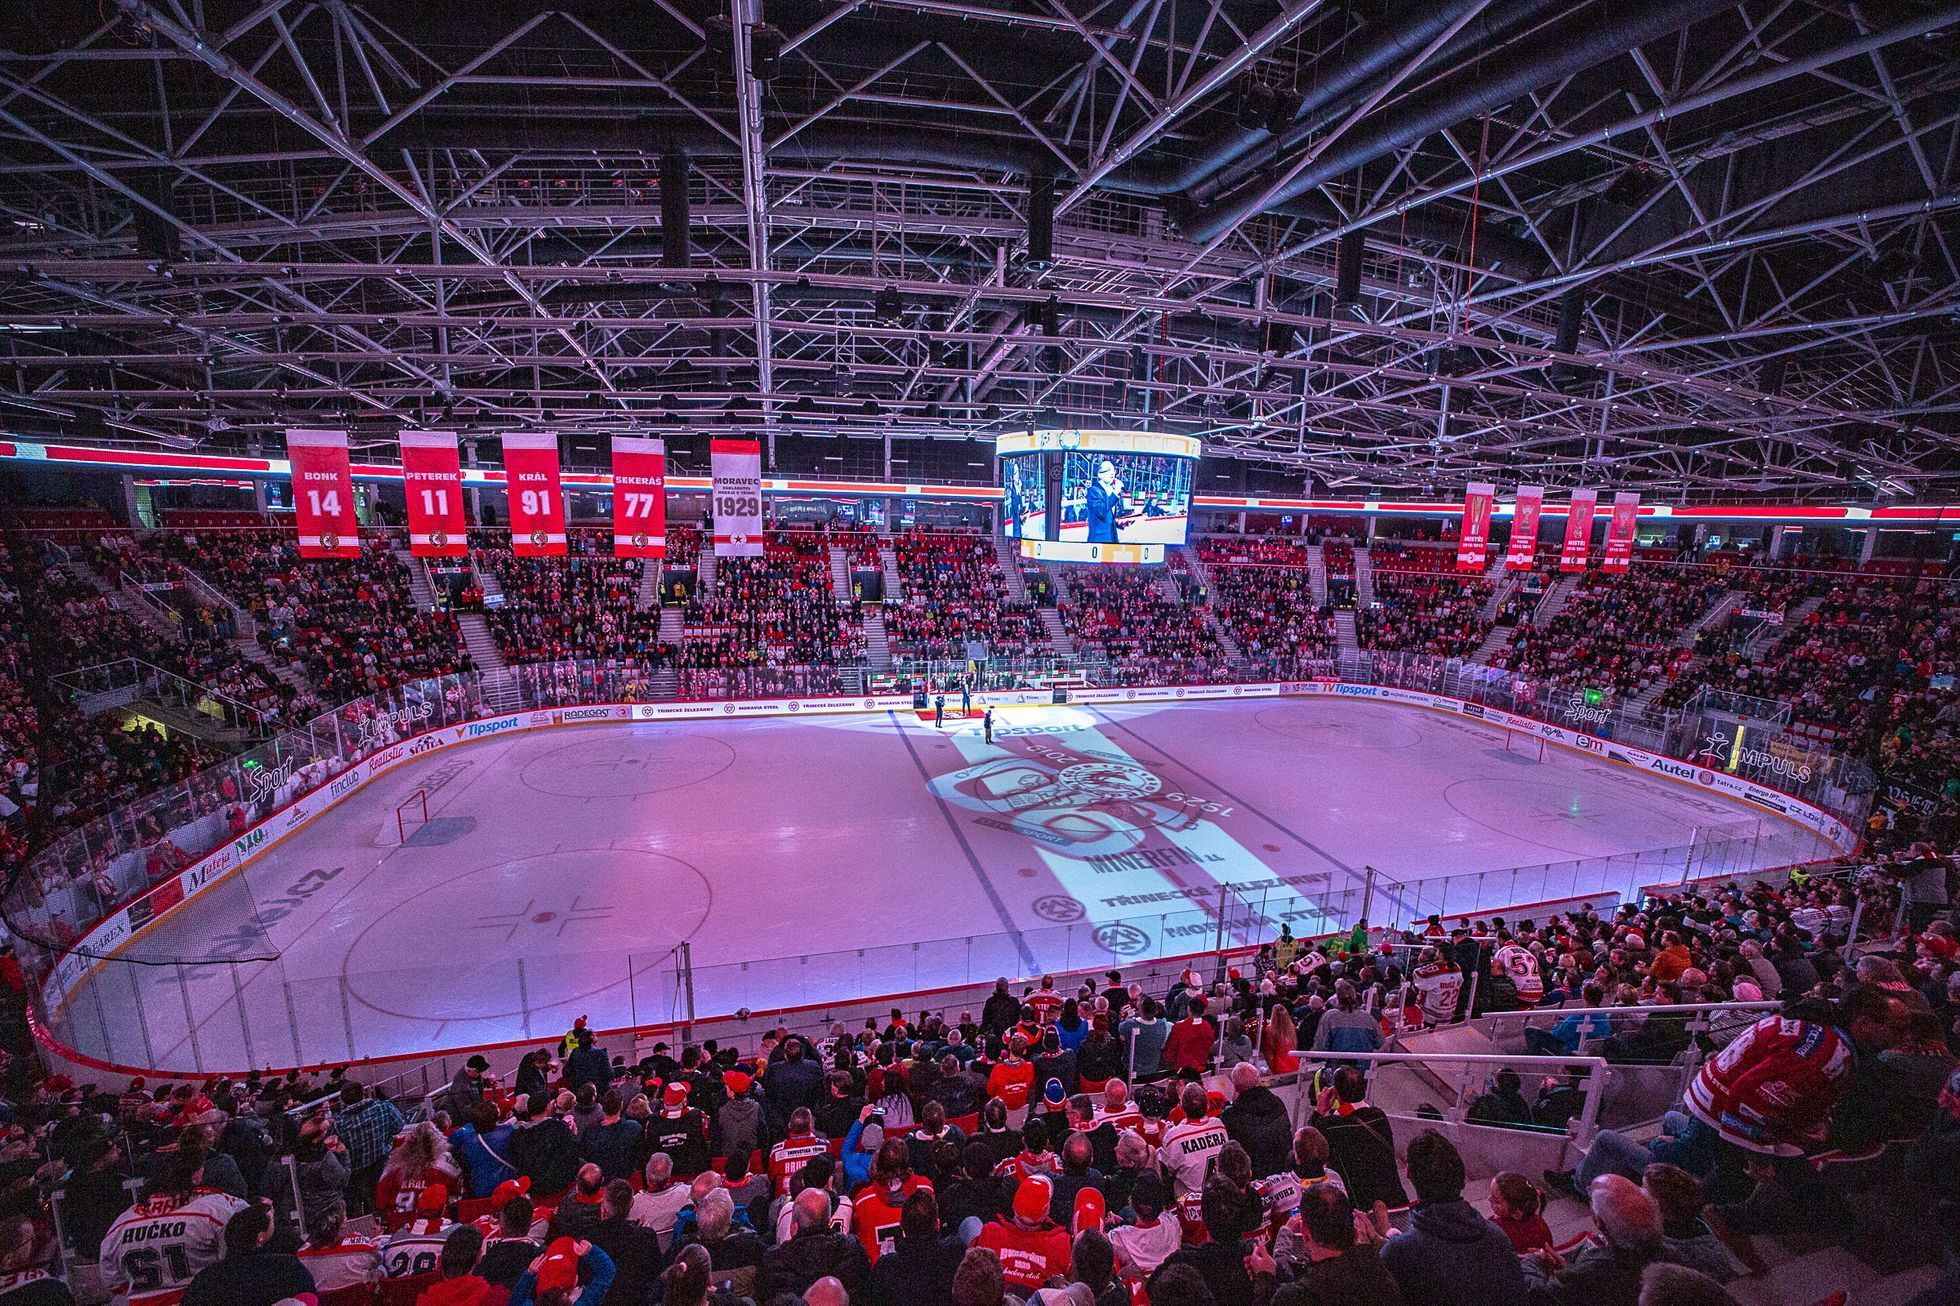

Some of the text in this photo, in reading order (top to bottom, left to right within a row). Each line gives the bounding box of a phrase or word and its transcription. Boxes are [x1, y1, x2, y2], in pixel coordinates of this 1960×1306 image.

[304, 472, 339, 481] BONK
[406, 472, 458, 481] PETEREK
[518, 471, 548, 481] KRÁL
[615, 475, 662, 486] SEKERÁŠ
[714, 477, 759, 485] MORAVEC
[306, 489, 342, 517] 14
[420, 489, 449, 516] 11
[521, 489, 550, 516] 91
[624, 492, 654, 518] 77
[715, 496, 760, 517] 1929
[1091, 546, 1098, 559] 0
[564, 708, 611, 720] RADEGAST
[1505, 716, 1537, 731] Realistic
[468, 717, 519, 736] Tipsport
[368, 746, 404, 776] Realistic
[1651, 759, 1696, 780] Autel
[330, 769, 360, 797] finclub
[1716, 779, 1743, 792] tatra.cz
[1748, 785, 1770, 797] Energo
[1082, 845, 1205, 874] MINERFIN
[1277, 905, 1348, 923] STEEL
[1180, 1132, 1227, 1155] KADĚRA
[121, 1219, 187, 1244] HUČKO
